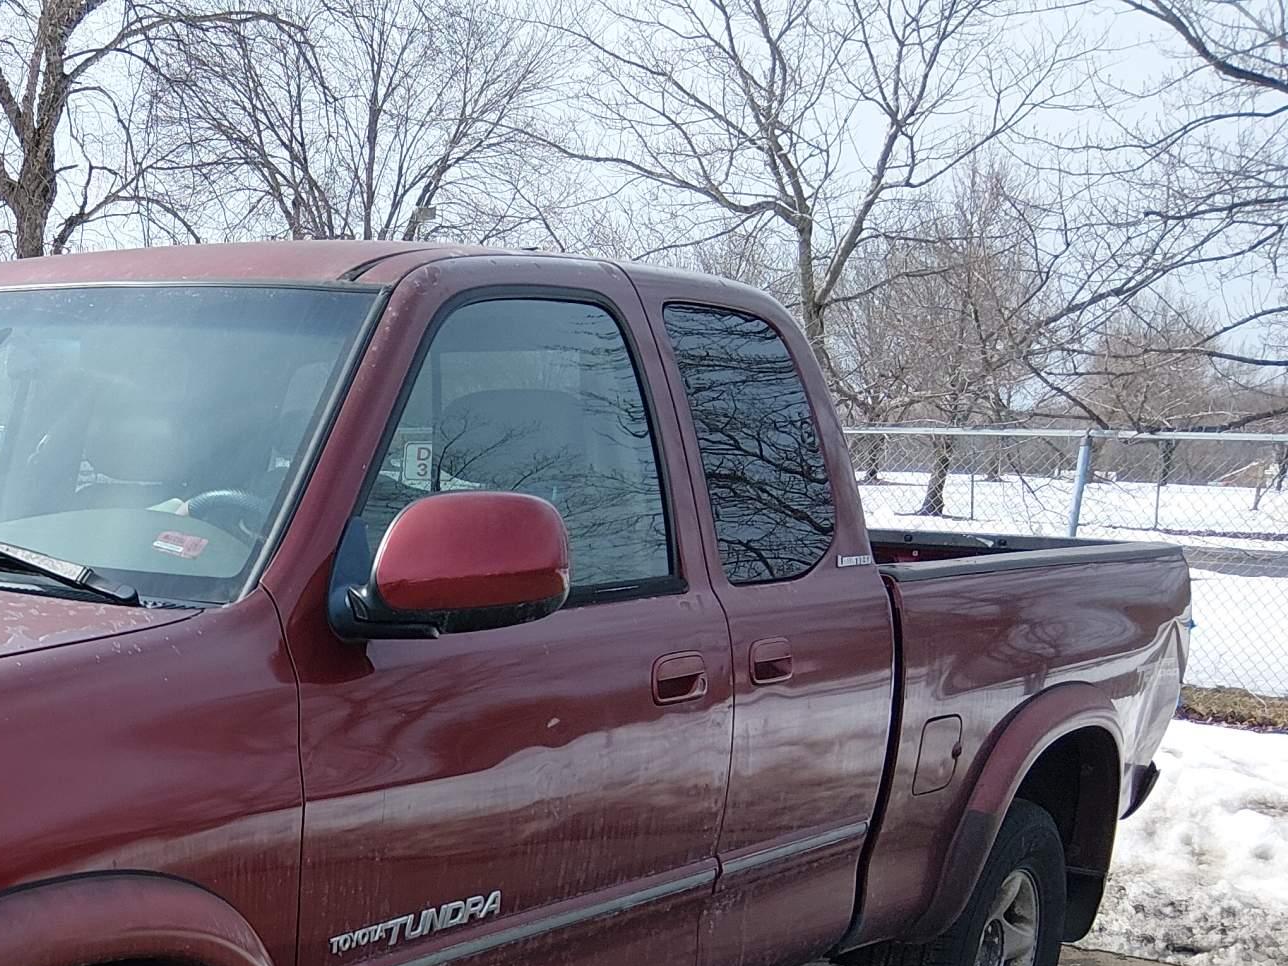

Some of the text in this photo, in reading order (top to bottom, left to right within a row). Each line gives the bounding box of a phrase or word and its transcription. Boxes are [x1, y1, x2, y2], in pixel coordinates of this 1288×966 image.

[416, 447, 431, 461] D
[417, 463, 428, 477] 3
[329, 890, 502, 955] TOYOTA TUNDRA
